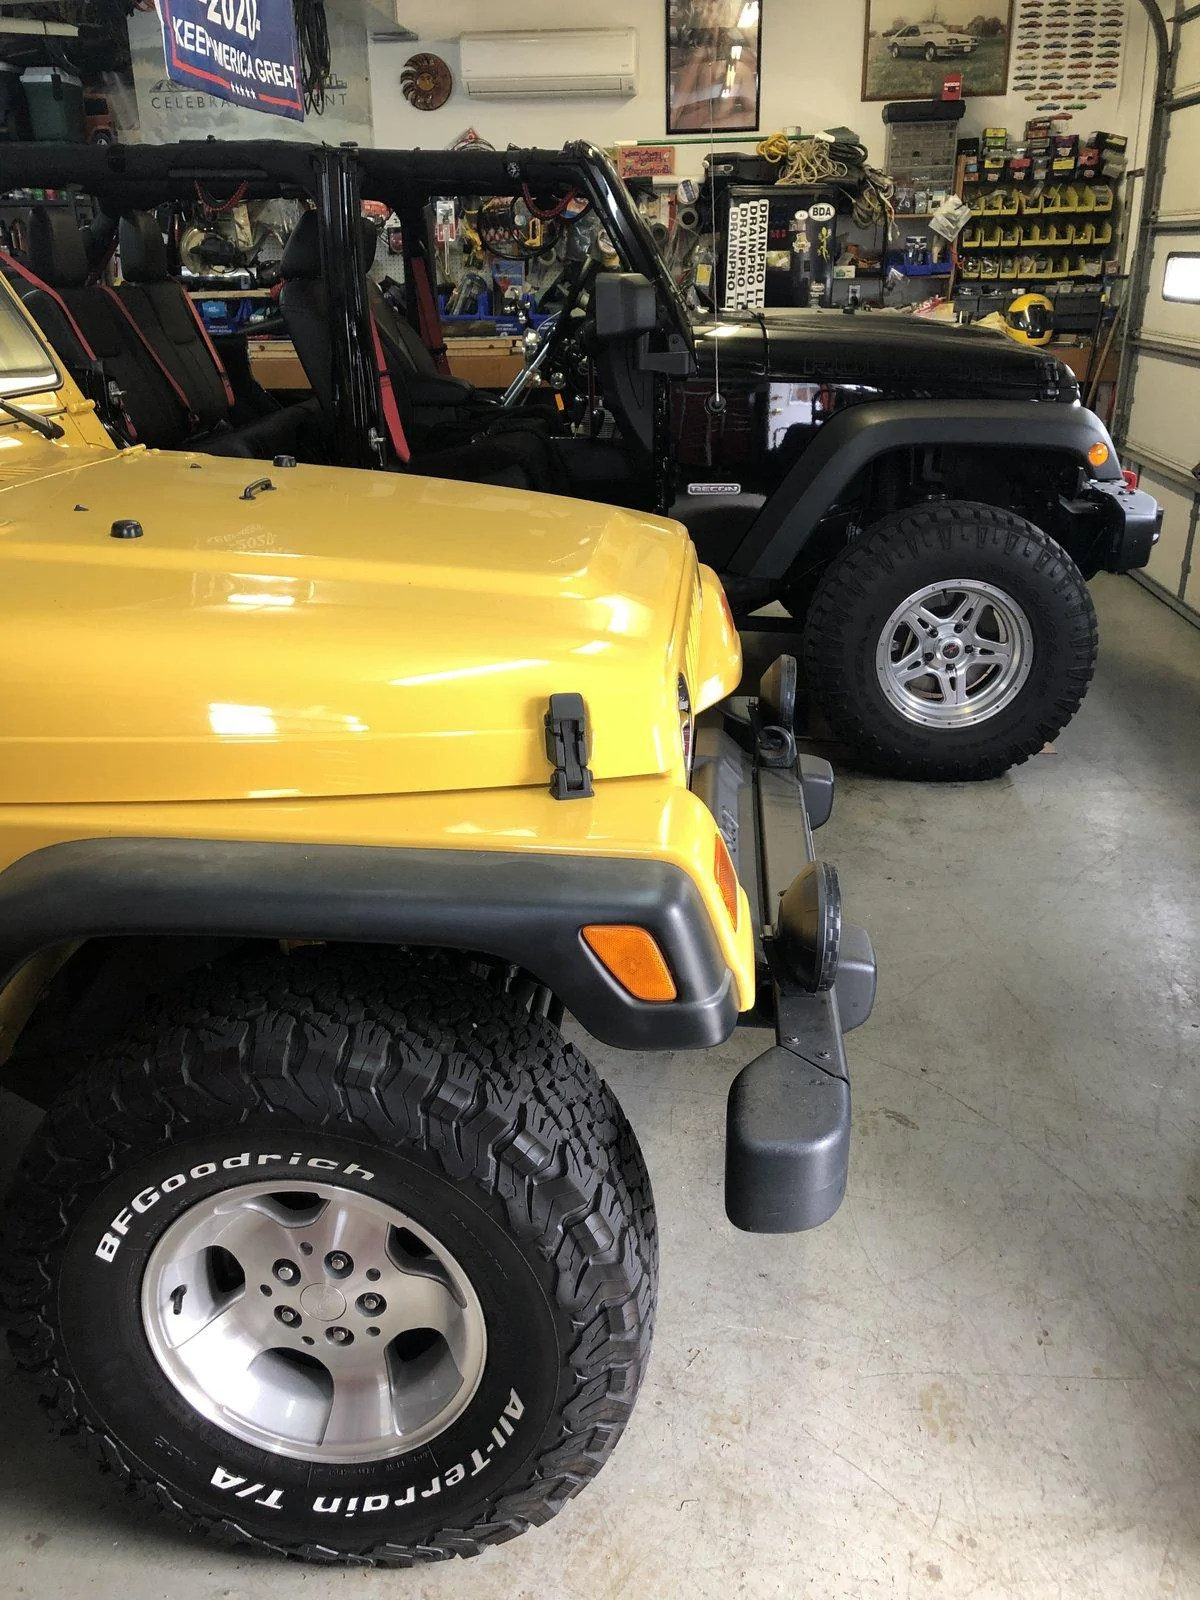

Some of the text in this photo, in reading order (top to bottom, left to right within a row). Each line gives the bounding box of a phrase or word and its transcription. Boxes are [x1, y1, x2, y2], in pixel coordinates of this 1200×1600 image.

[255, 58, 297, 89] GREAT
[727, 211, 739, 291] DRAINPRO
[737, 207, 748, 288] DRAINPRO
[747, 205, 758, 286] DRAINPRO
[756, 203, 768, 284] DRAINPRO
[812, 206, 832, 217] BDA
[690, 485, 739, 493] RECON
[95, 1152, 376, 1263] BFGoodrich
[210, 1466, 285, 1510] T/A
[312, 1387, 525, 1518] All-Terrain
